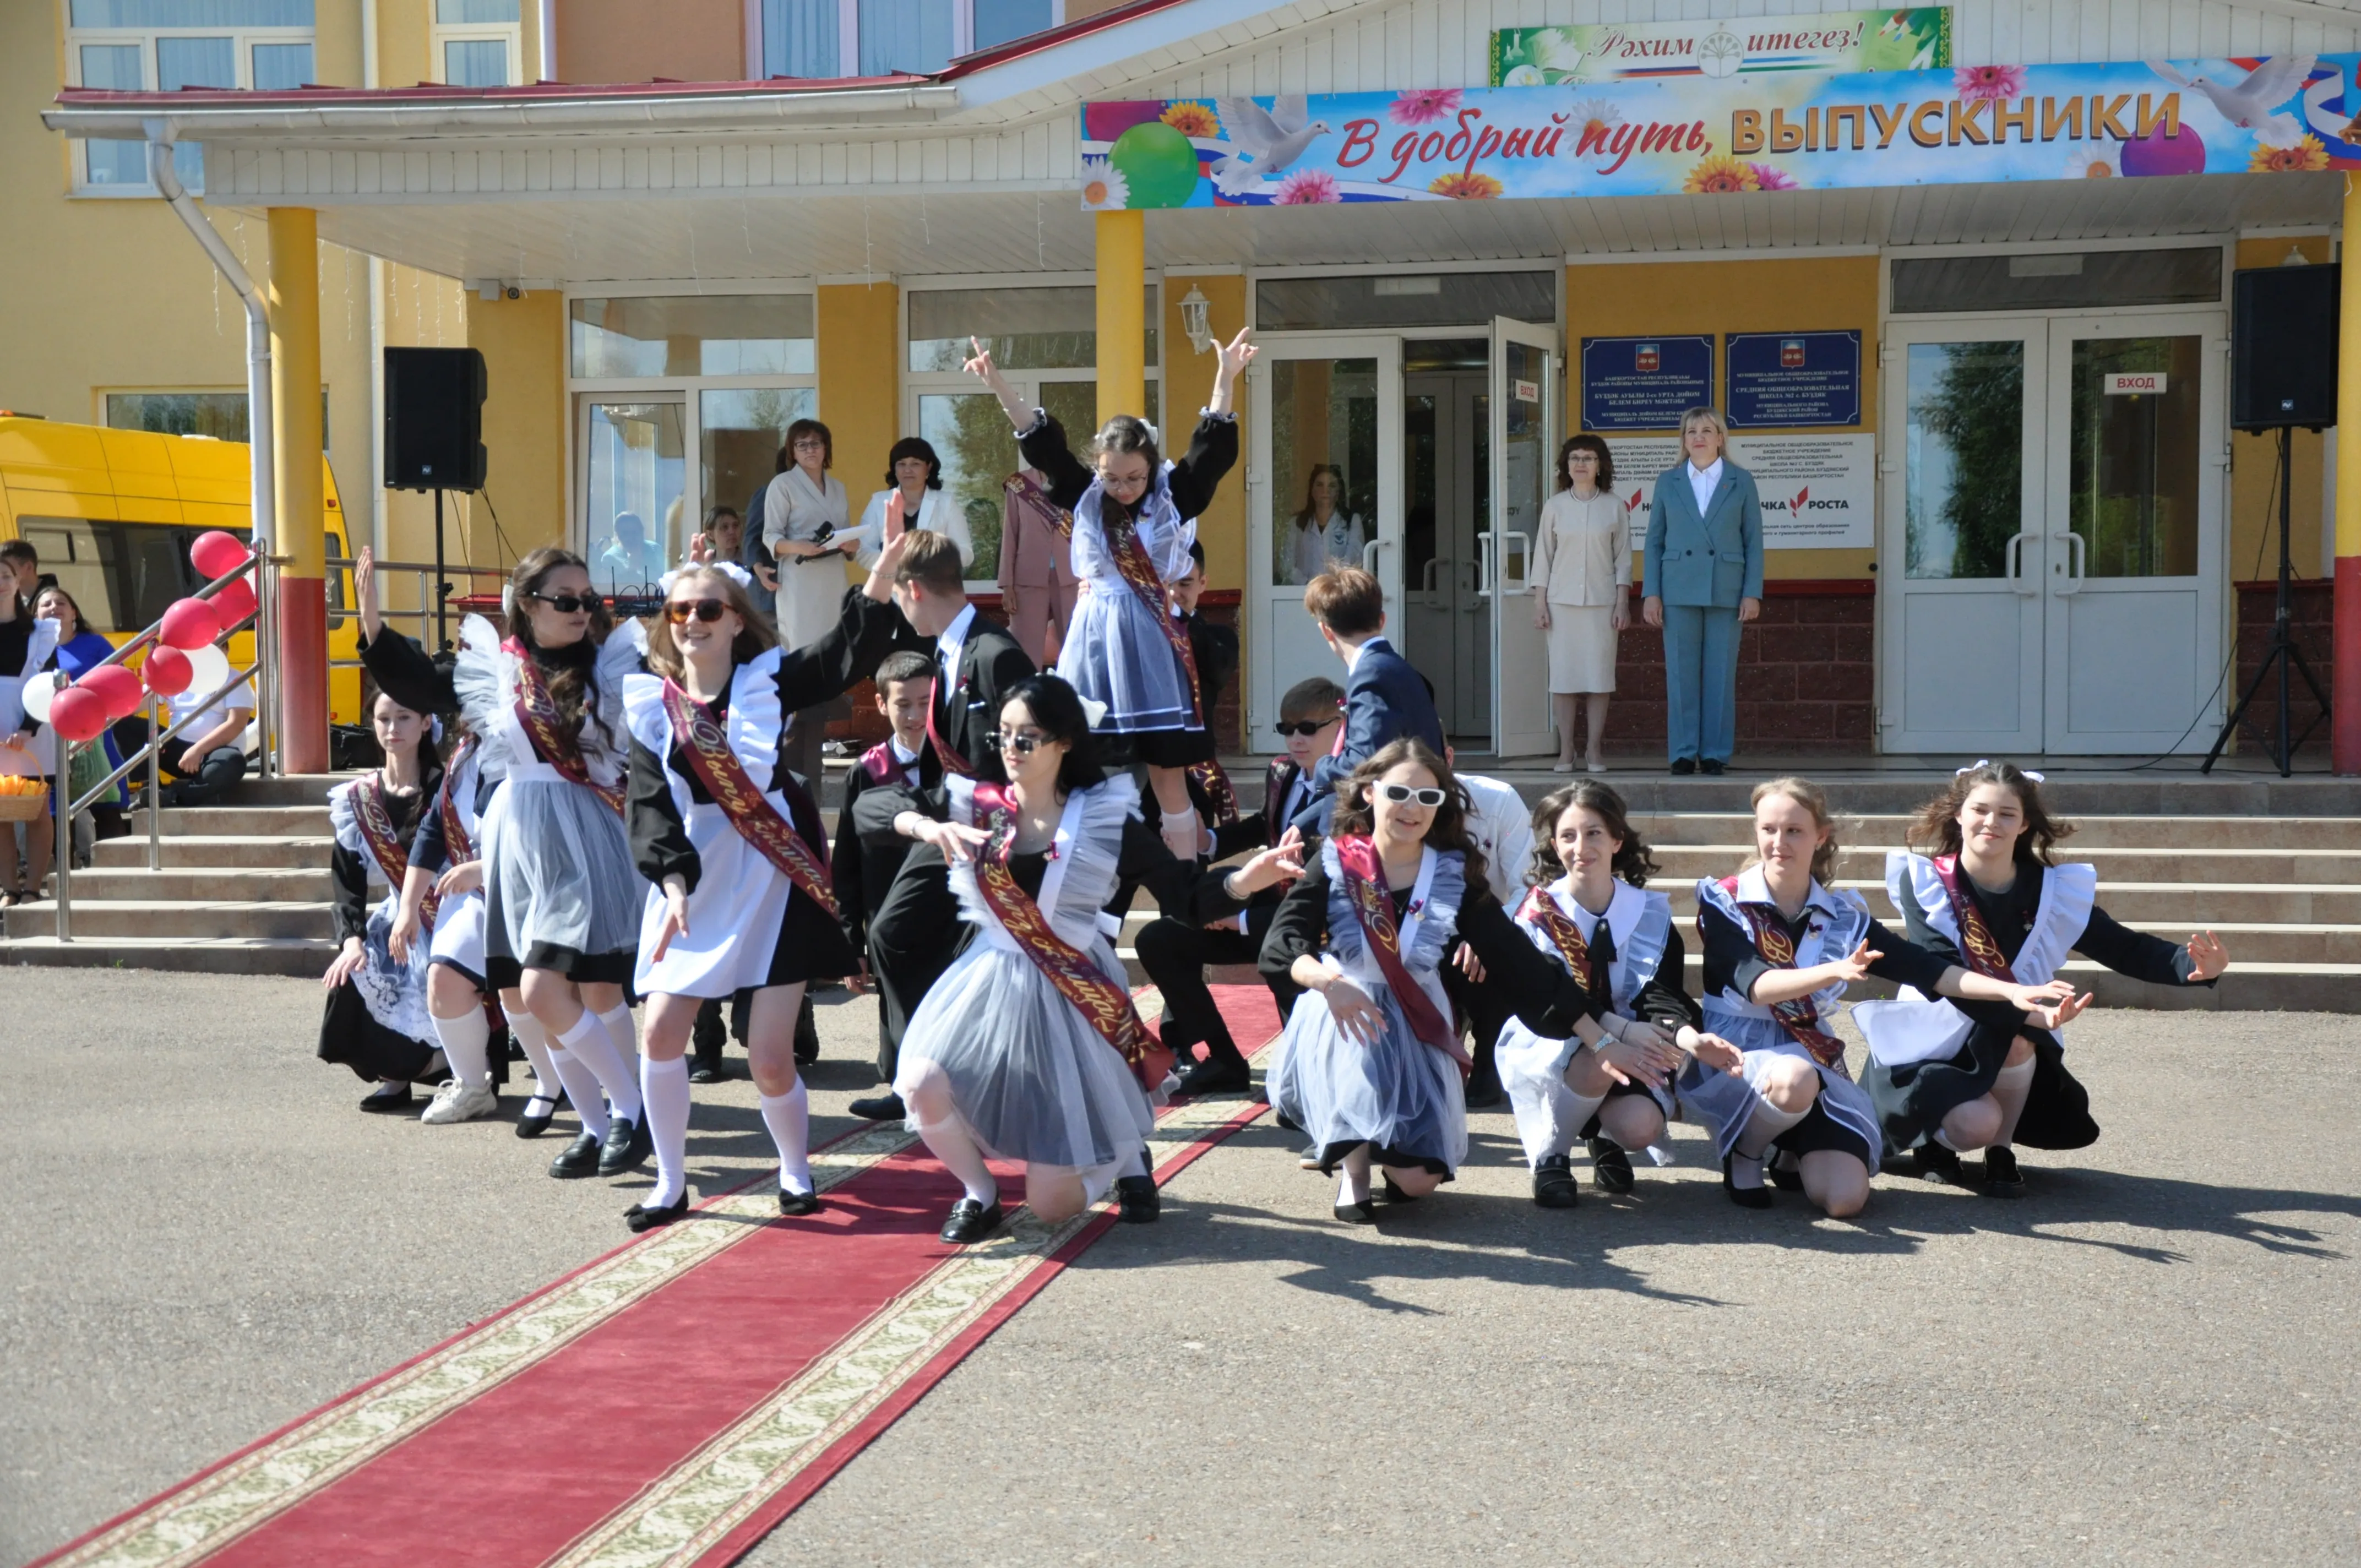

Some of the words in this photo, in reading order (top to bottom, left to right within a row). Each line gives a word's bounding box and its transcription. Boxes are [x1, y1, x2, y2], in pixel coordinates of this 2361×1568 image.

[1337, 118, 1379, 167] В
[1378, 107, 1570, 183] добрый
[1575, 117, 1712, 176] путь,
[1731, 91, 2181, 155] ВЫПУСКНИКИ
[2117, 377, 2155, 389] ВХОД
[1520, 385, 1535, 398] ВХОД
[1761, 501, 1787, 510] ЧКА
[1808, 500, 1849, 509] РОСТА
